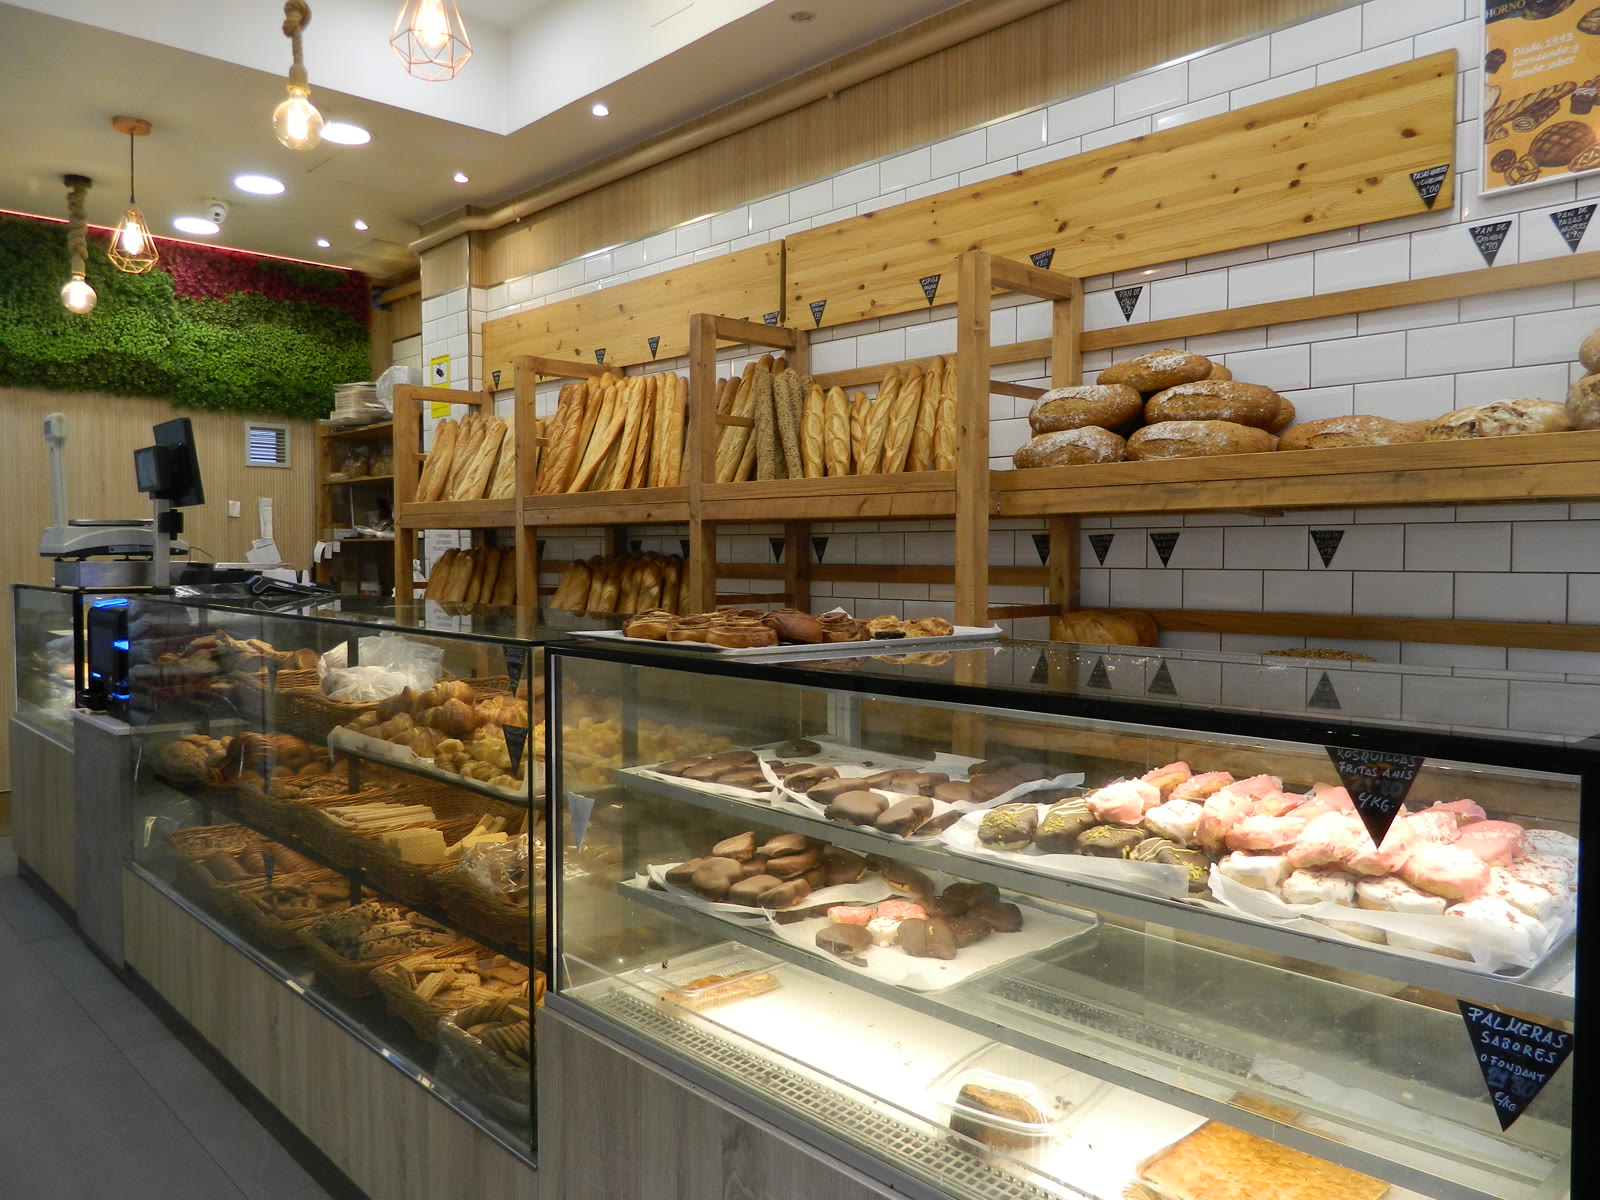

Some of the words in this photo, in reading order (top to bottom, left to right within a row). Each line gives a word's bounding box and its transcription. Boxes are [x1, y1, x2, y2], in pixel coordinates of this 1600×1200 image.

[1486, 0, 1526, 19] HORNO
[1512, 42, 1542, 57] Desde
[1555, 209, 1575, 219] PAN
[1474, 225, 1493, 235] PAN
[1496, 222, 1508, 232] DE
[1337, 748, 1417, 767] ROSQUILLAS
[1467, 1006, 1568, 1049] PALMERAS
[1480, 1030, 1558, 1065] SABORES
[1490, 1055, 1546, 1083] FONDANT
